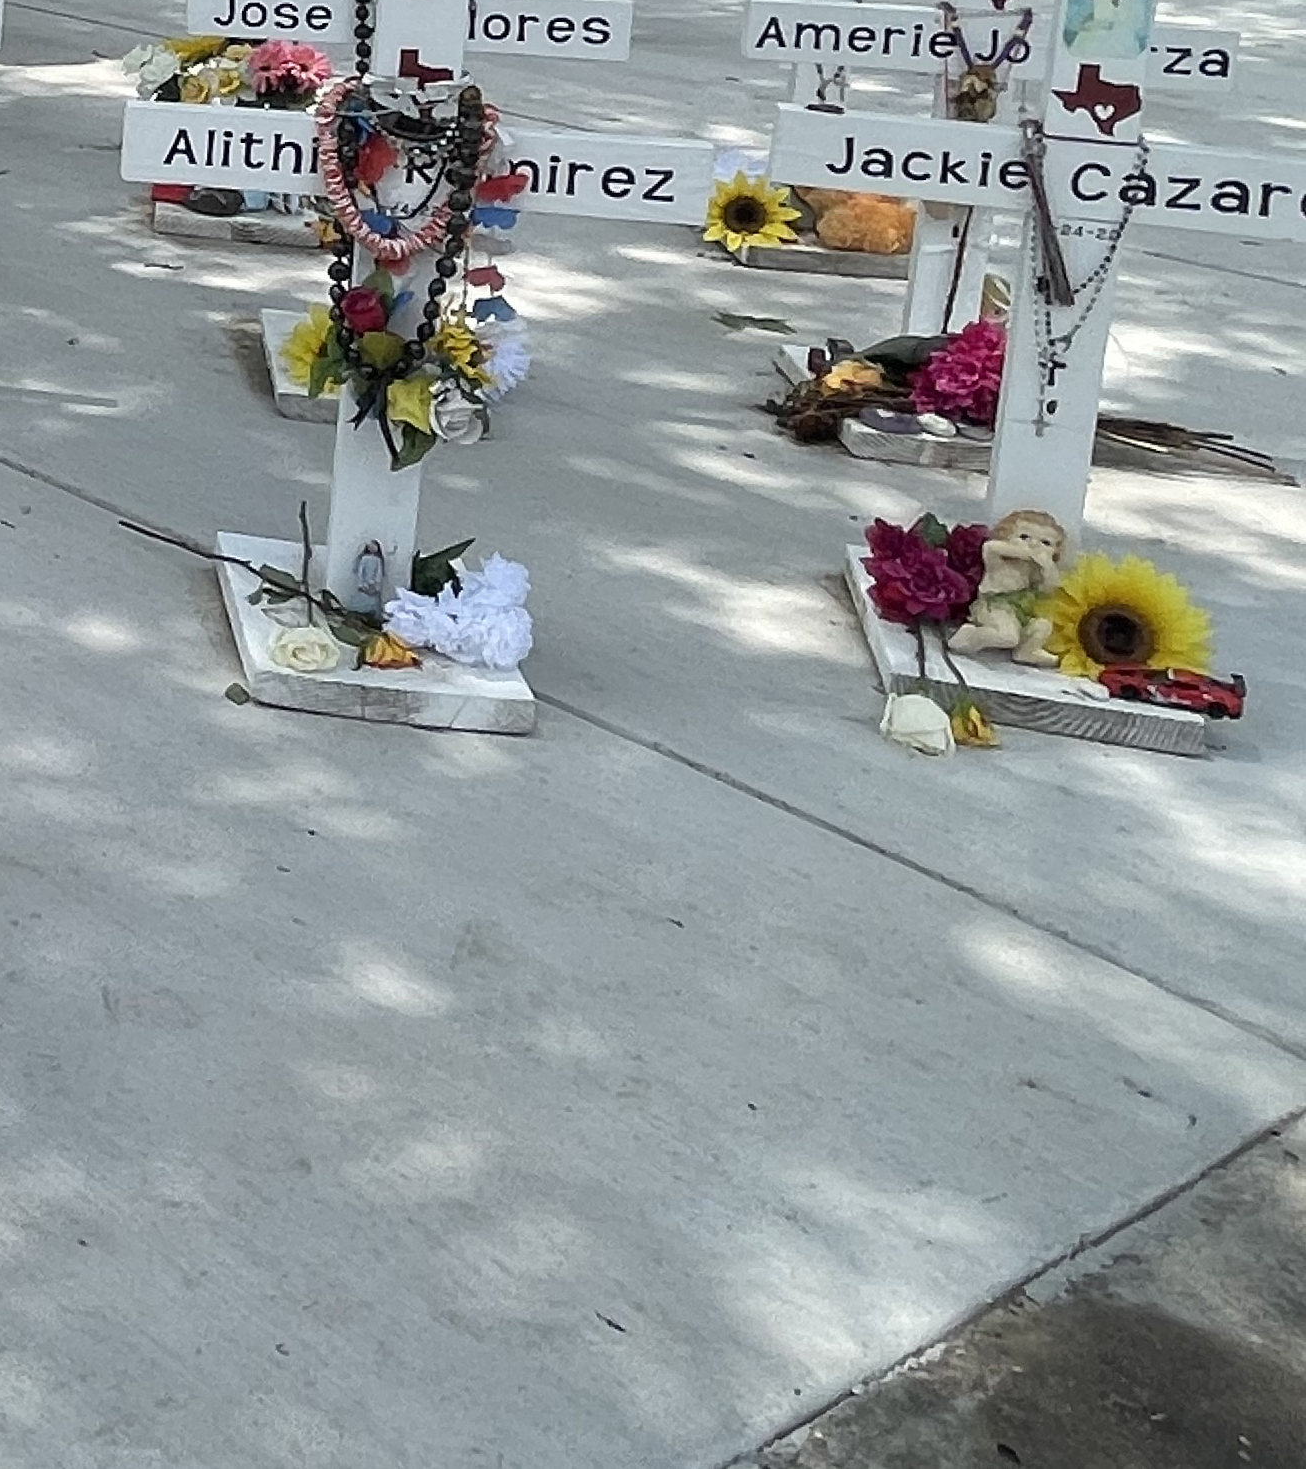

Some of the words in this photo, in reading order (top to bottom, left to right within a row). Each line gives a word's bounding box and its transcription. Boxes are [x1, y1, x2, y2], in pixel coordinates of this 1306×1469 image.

[754, 16, 958, 58] Amerie
[974, 29, 1031, 64] Jo
[162, 127, 321, 175] Alithi
[825, 135, 1032, 190] Jackie
[1071, 162, 1306, 218] Cazar
